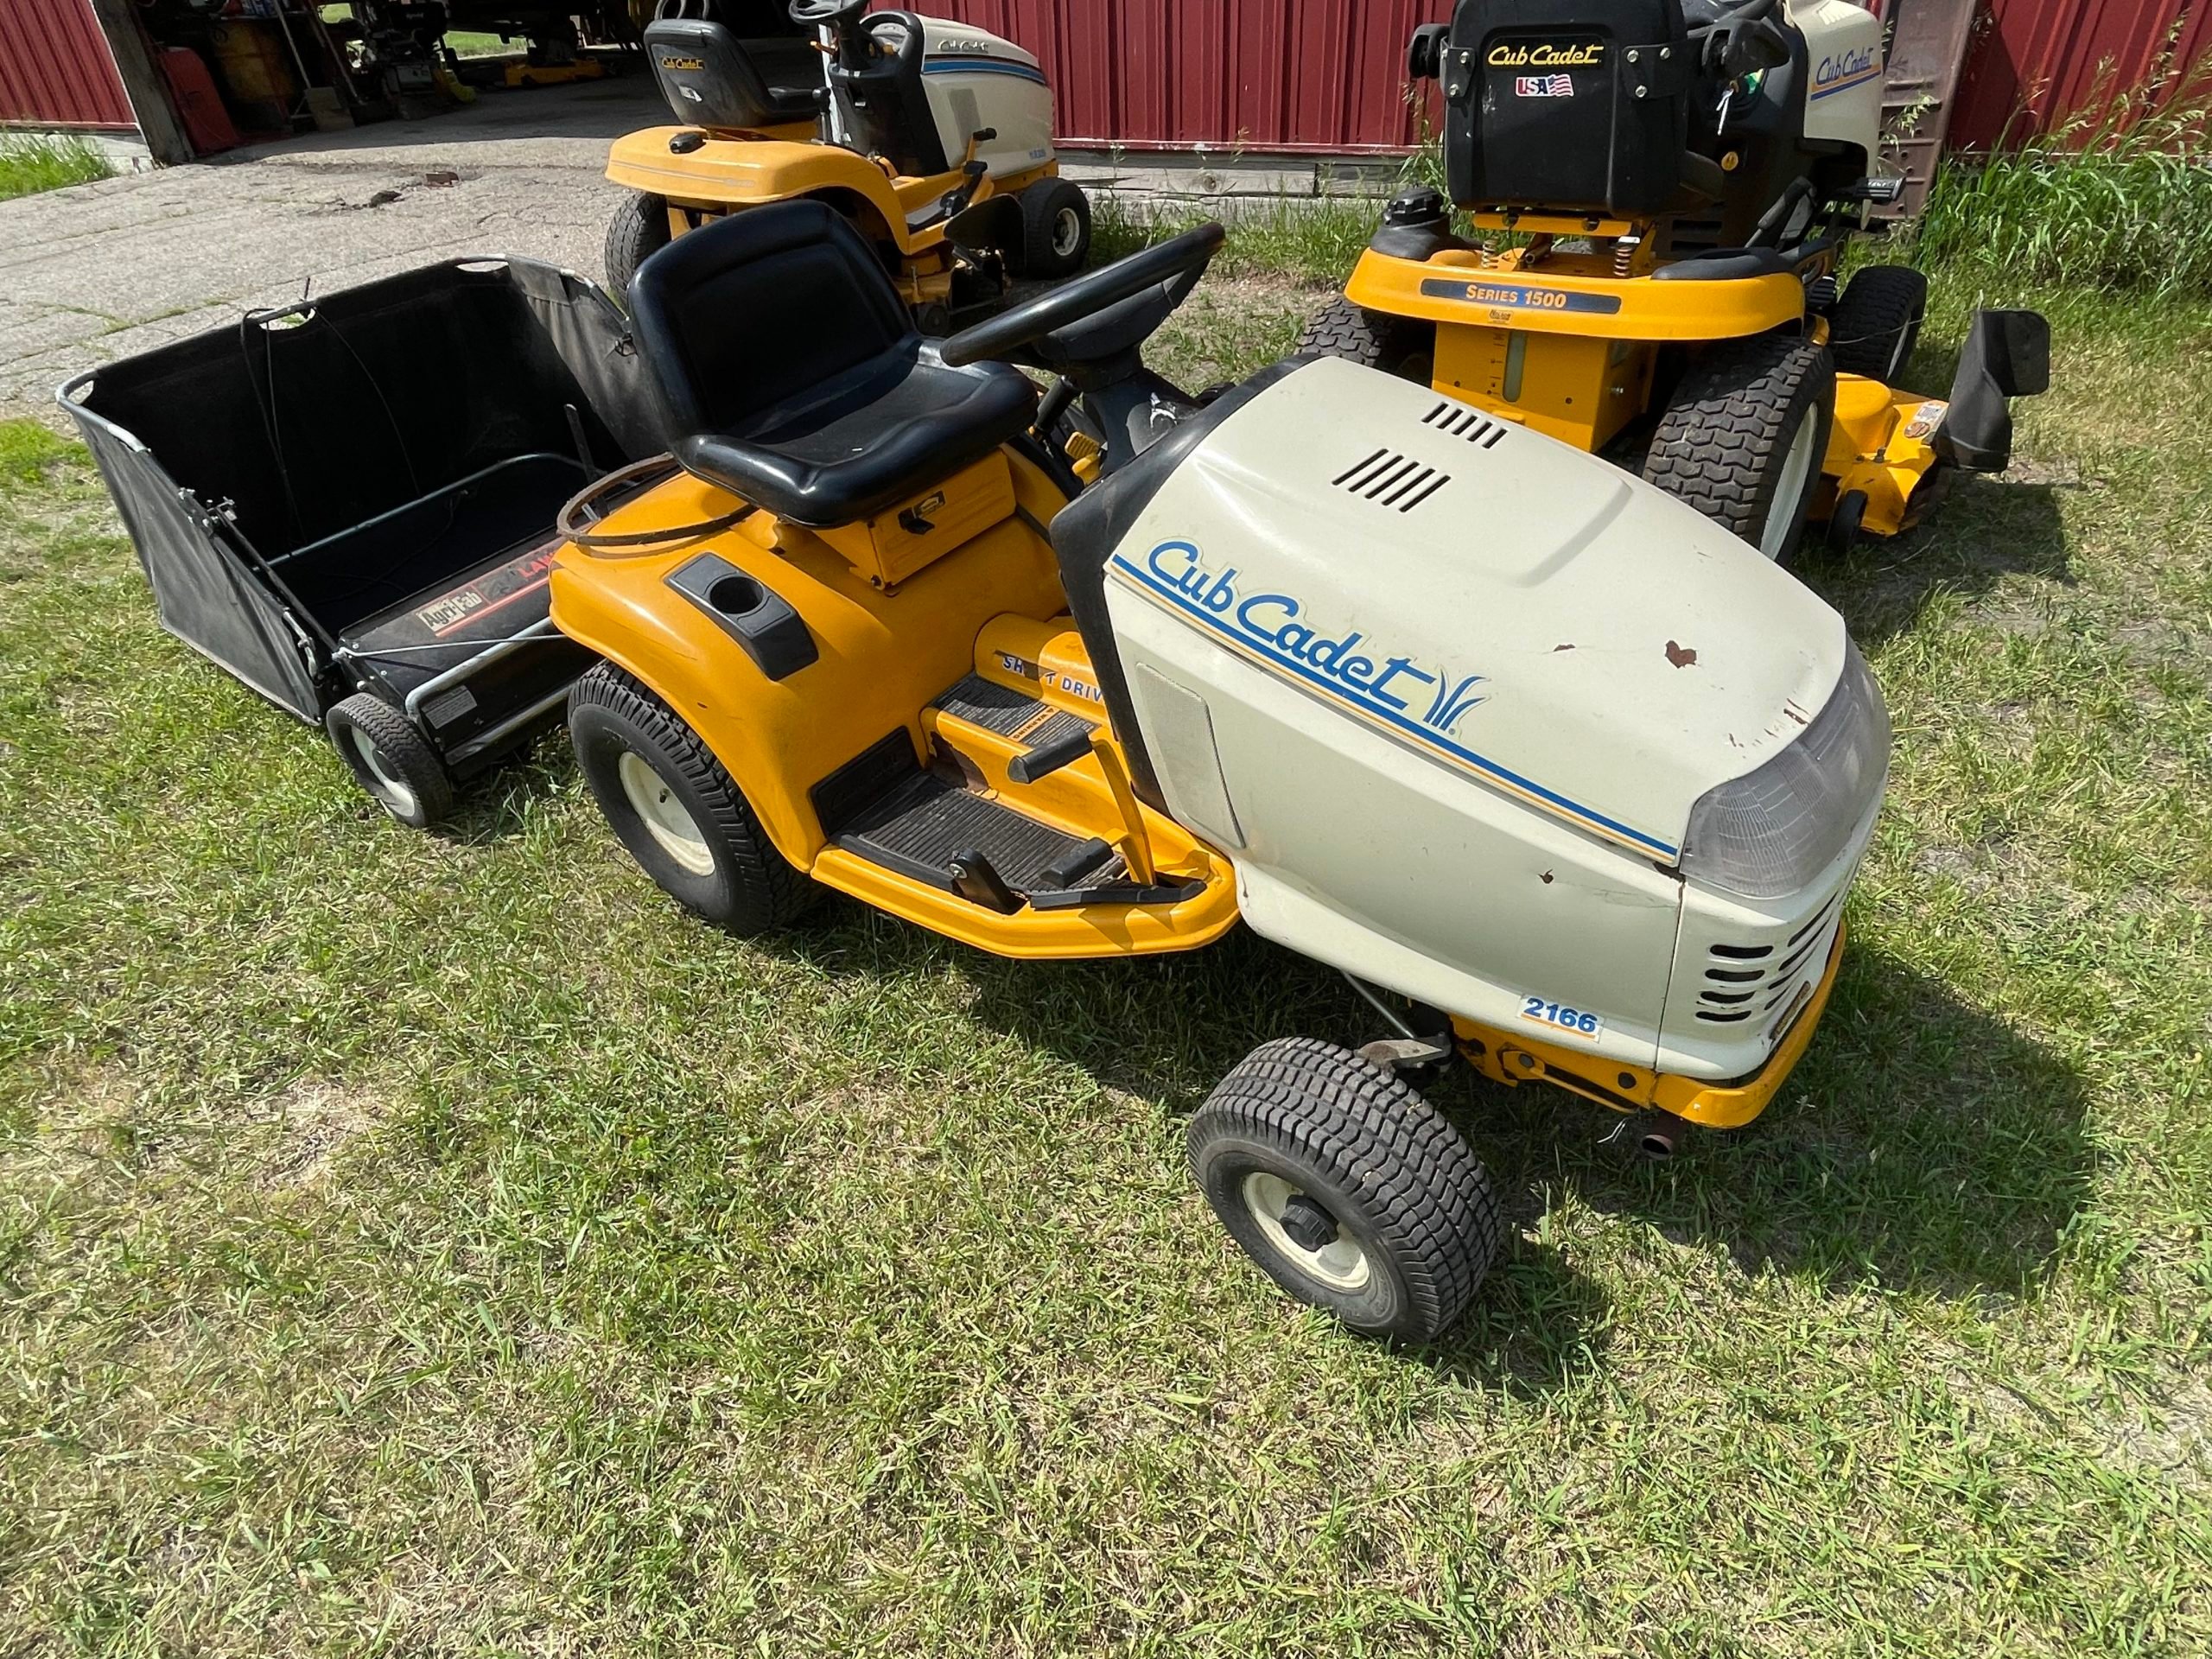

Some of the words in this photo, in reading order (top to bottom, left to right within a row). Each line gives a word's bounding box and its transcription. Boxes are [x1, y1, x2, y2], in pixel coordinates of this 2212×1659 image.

[1488, 46, 1529, 65] Cub
[1529, 44, 1605, 65] Cadet
[1816, 54, 1841, 85] Cub
[1842, 47, 1873, 78] Cadet
[1516, 78, 1548, 95] USA
[1524, 289, 1567, 308] 1500
[1148, 541, 1236, 613] Cub
[1236, 594, 1437, 711] Cadet
[1002, 656, 1057, 684] SHT
[1062, 677, 1103, 702] DRIV
[1012, 712, 1049, 741] WARNING
[1523, 997, 1598, 1033] 2166
